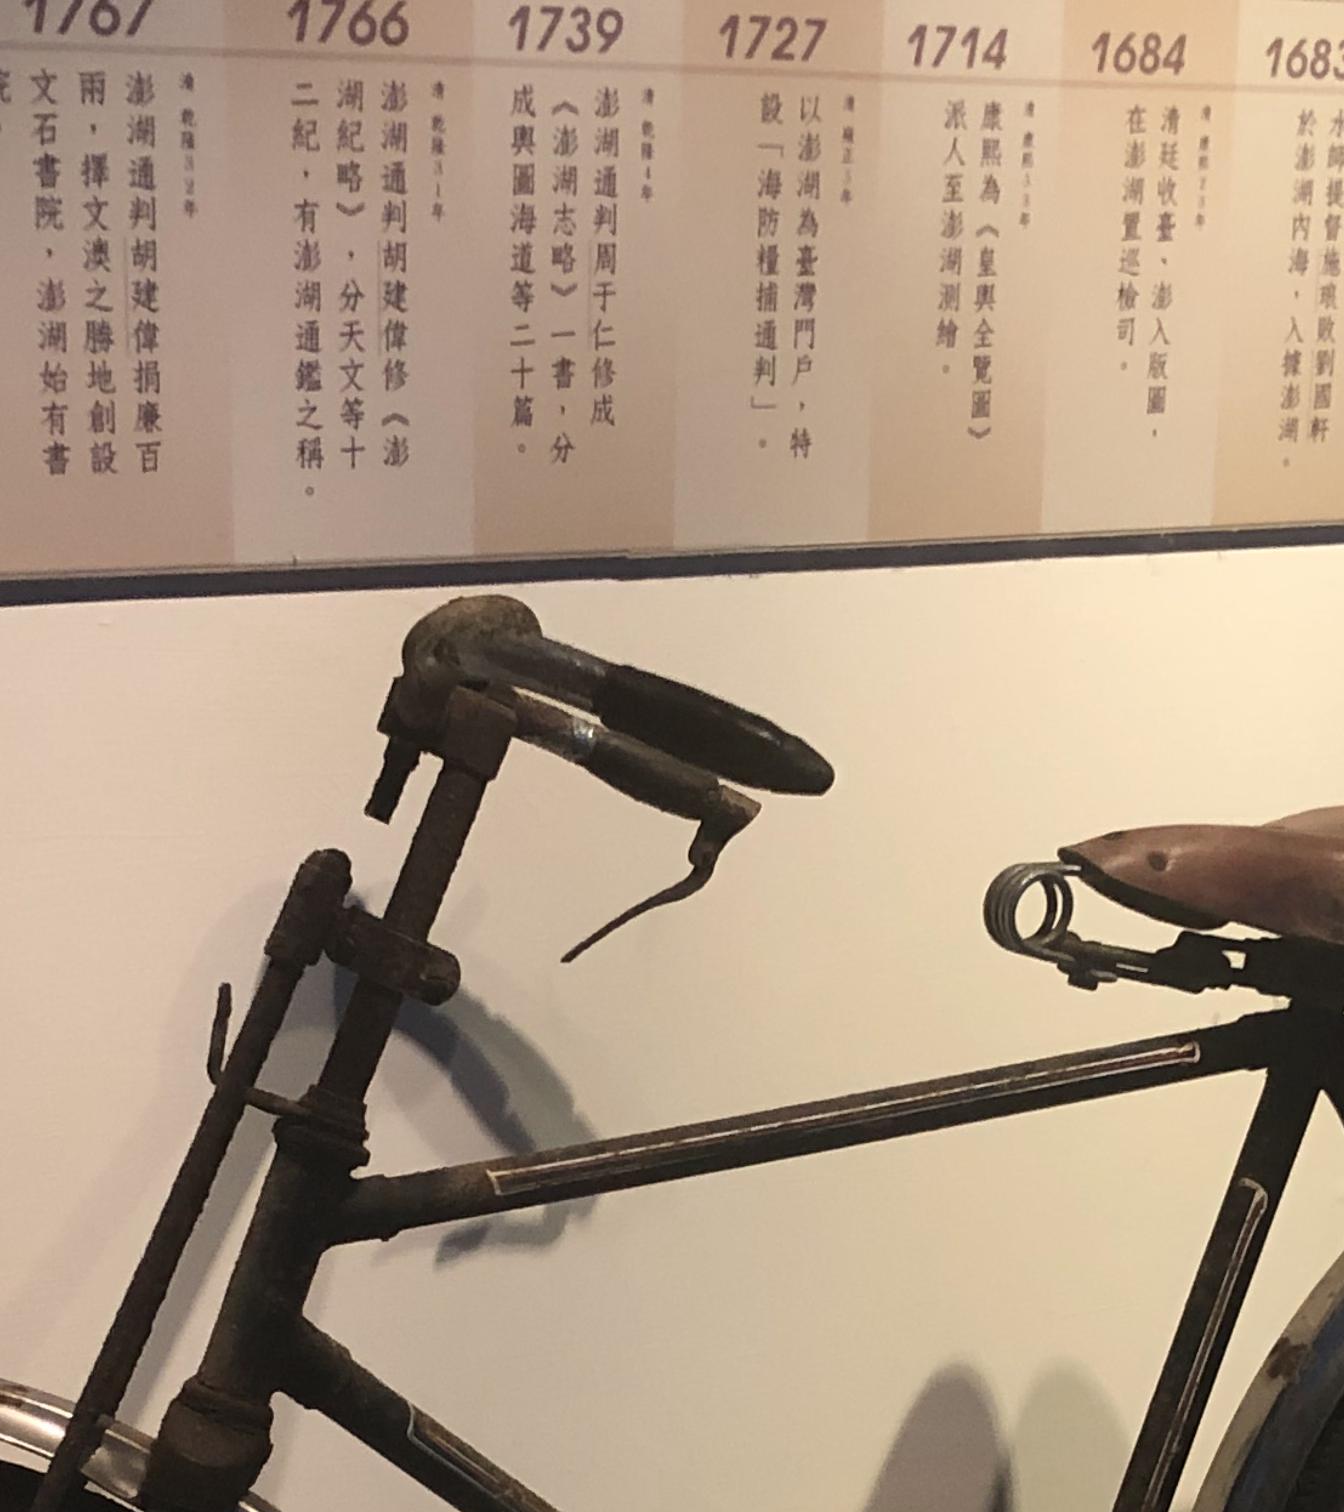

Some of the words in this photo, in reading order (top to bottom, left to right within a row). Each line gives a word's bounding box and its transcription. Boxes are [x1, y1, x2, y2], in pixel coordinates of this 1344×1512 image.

[24, 0, 154, 36] 1767
[288, 0, 409, 47] 1766
[508, 5, 624, 54] 1739
[719, 14, 828, 62] 1727
[907, 24, 1008, 70] 1714
[1091, 31, 1187, 76] 1684
[936, 98, 968, 375] 派人至澎湖測繪。
[29, 68, 71, 477] 文石書院，澎湖始有書
